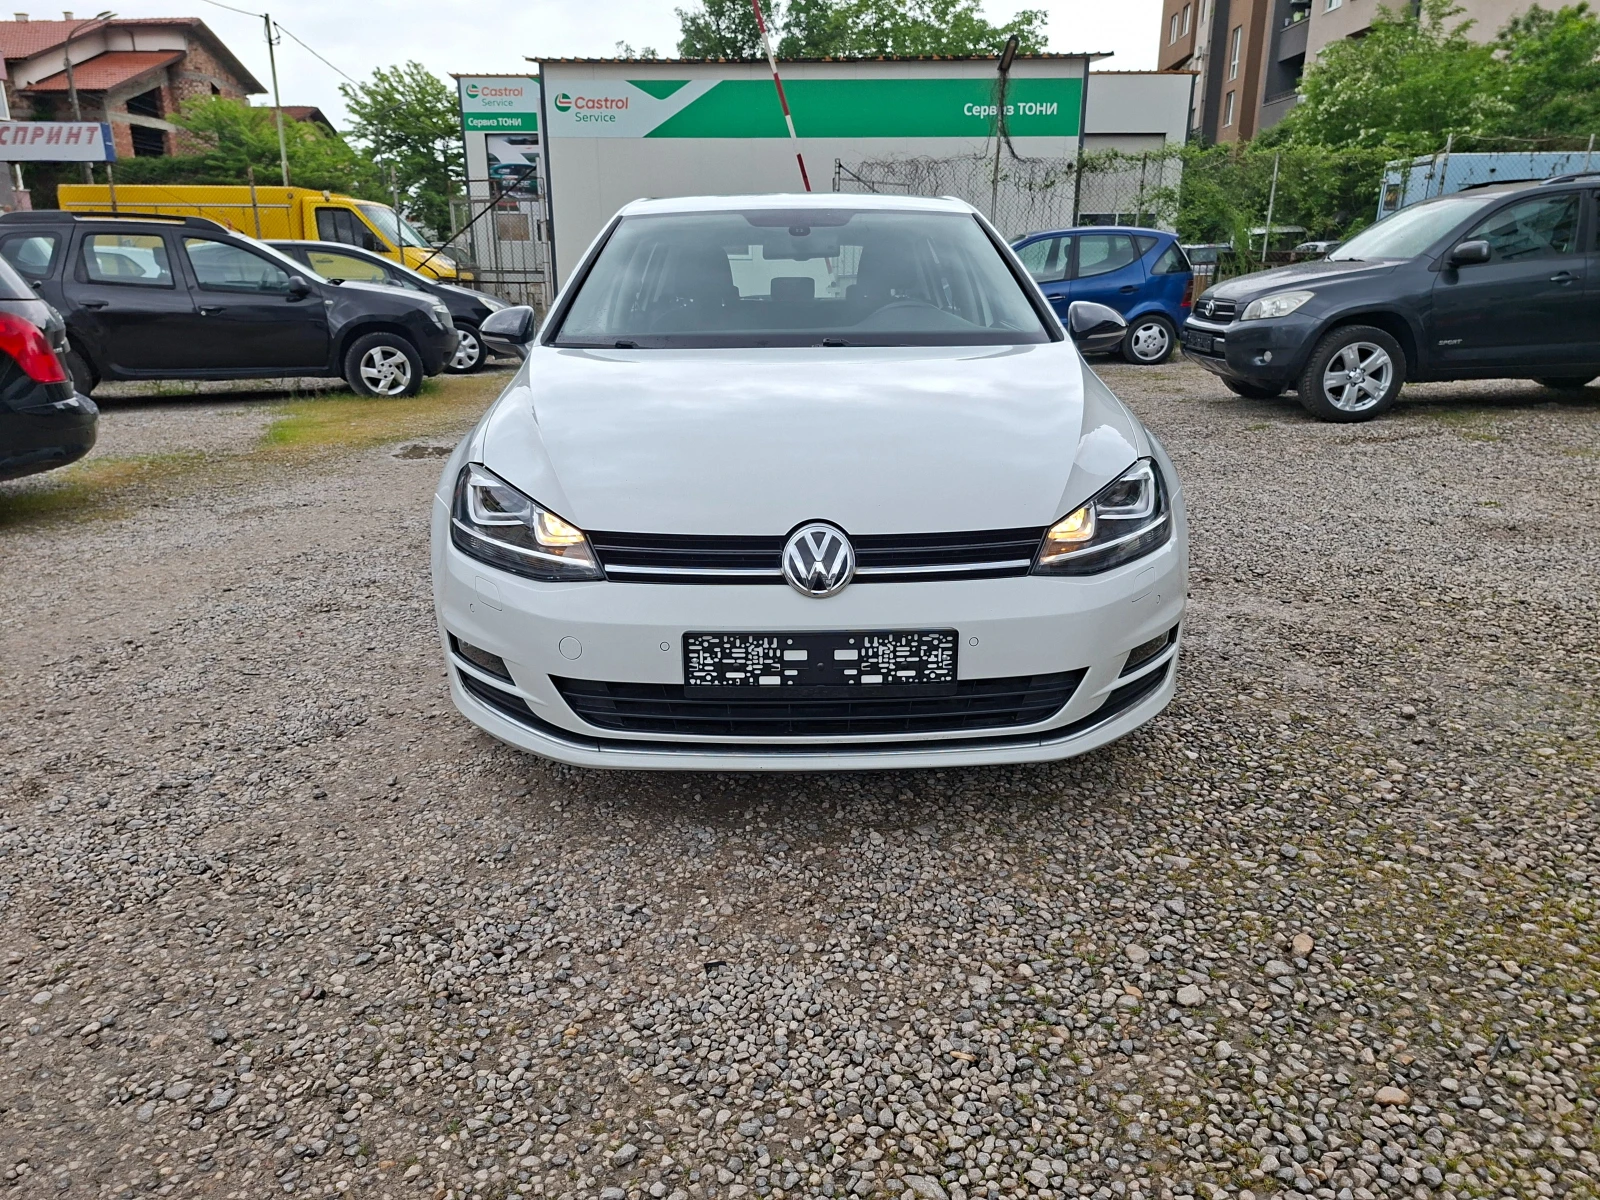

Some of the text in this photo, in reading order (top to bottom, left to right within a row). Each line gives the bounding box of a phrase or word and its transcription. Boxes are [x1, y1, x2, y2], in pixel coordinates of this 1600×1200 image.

[481, 86, 523, 97] Castrol
[481, 98, 514, 107] Service
[574, 96, 629, 110] Castrol
[1017, 102, 1058, 115] ТОНИ
[575, 111, 616, 122] Service
[467, 117, 522, 128] Сервиз ТОНИ
[0, 126, 99, 145] СПРИНТ
[1437, 338, 1463, 346] SPORT
